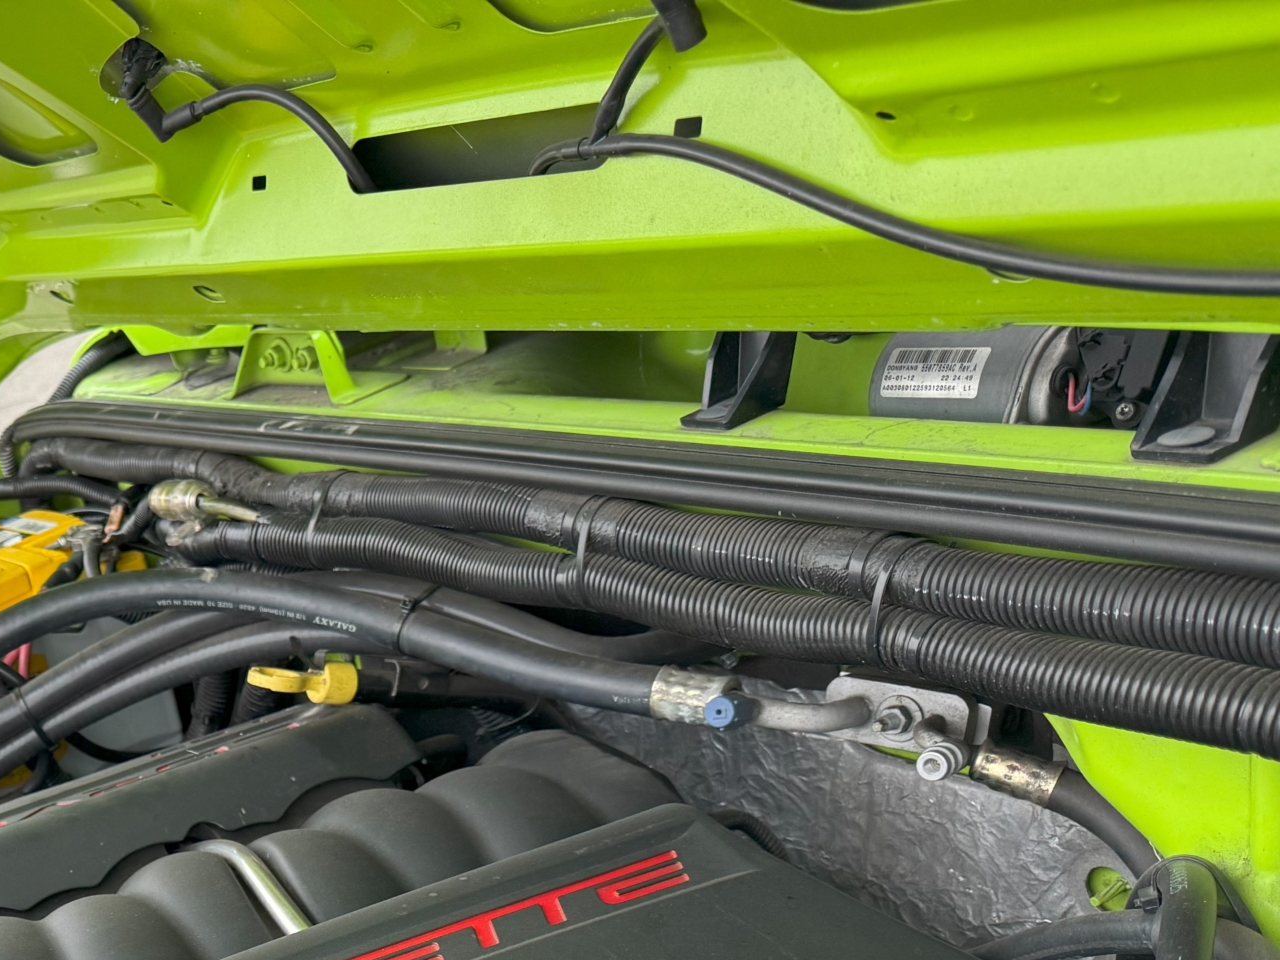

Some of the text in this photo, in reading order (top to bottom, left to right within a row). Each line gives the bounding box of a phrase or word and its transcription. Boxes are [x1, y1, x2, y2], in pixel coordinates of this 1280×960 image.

[886, 364, 918, 372] DONGYANG
[183, 599, 204, 607] MADE
[313, 616, 357, 633] GALAXY
